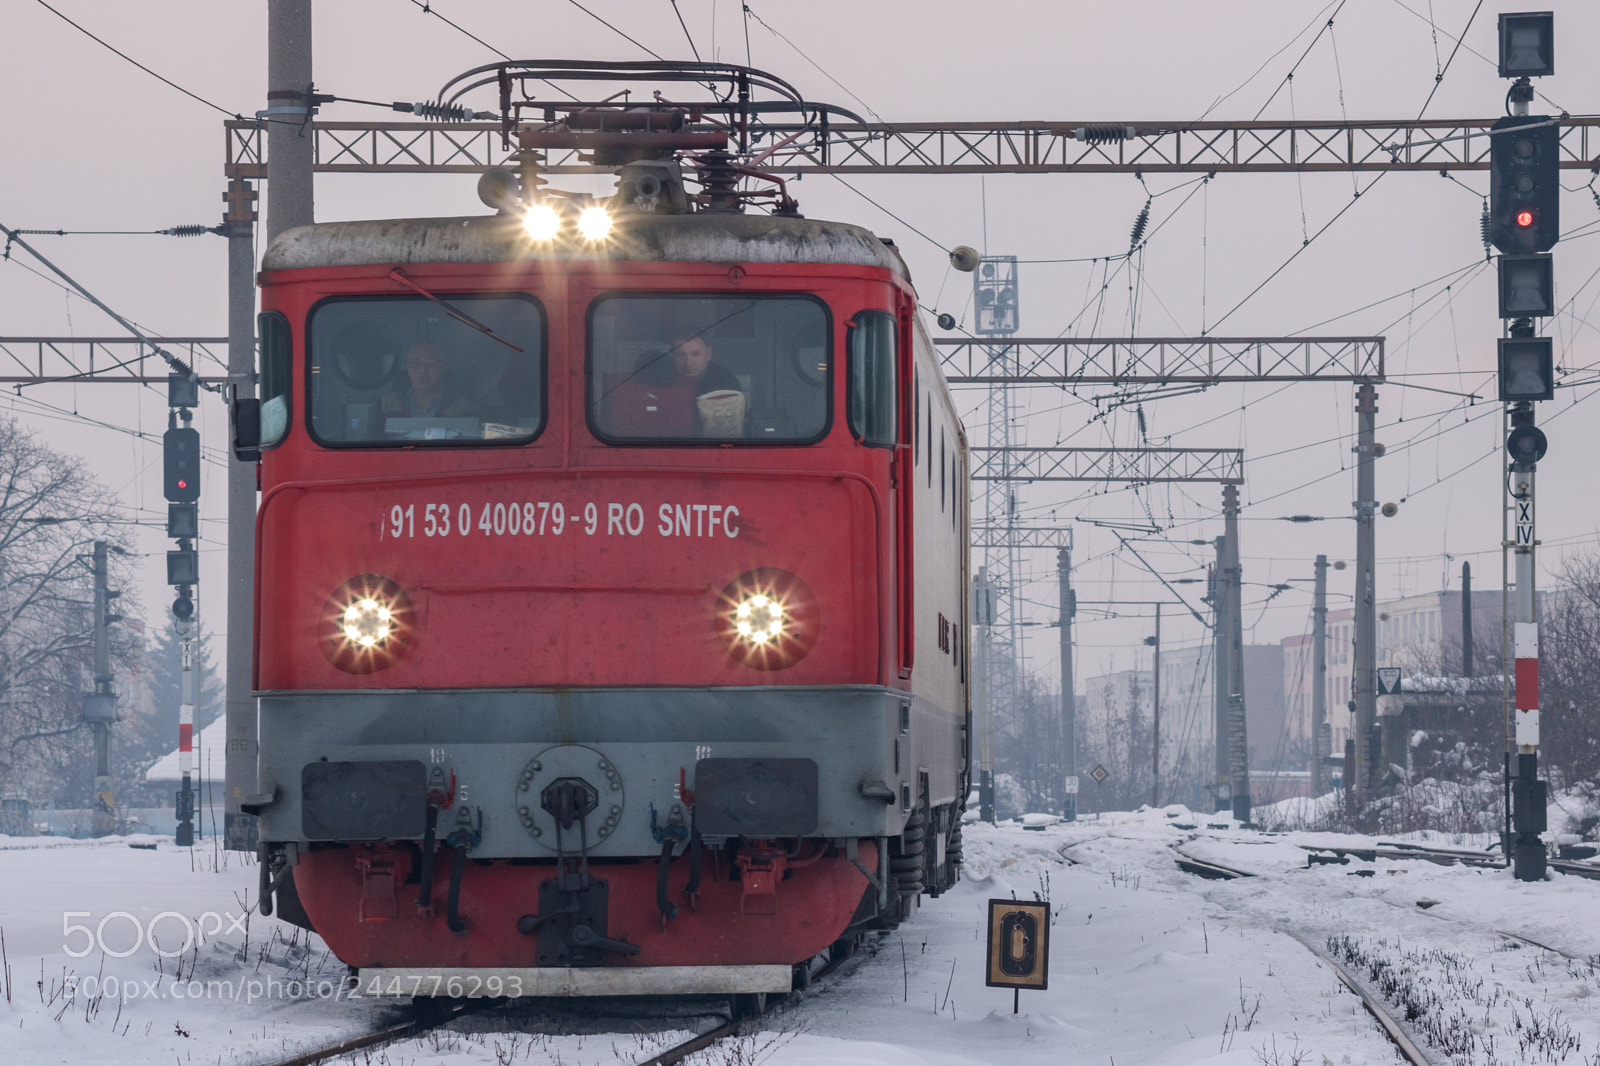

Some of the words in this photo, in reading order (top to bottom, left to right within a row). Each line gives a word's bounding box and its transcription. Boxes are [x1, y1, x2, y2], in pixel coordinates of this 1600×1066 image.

[391, 504, 415, 538] 91
[424, 503, 451, 537] 53
[458, 503, 471, 536] 0
[607, 502, 645, 536] RO
[657, 503, 741, 539] SNTFC
[999, 911, 1037, 977] 0
